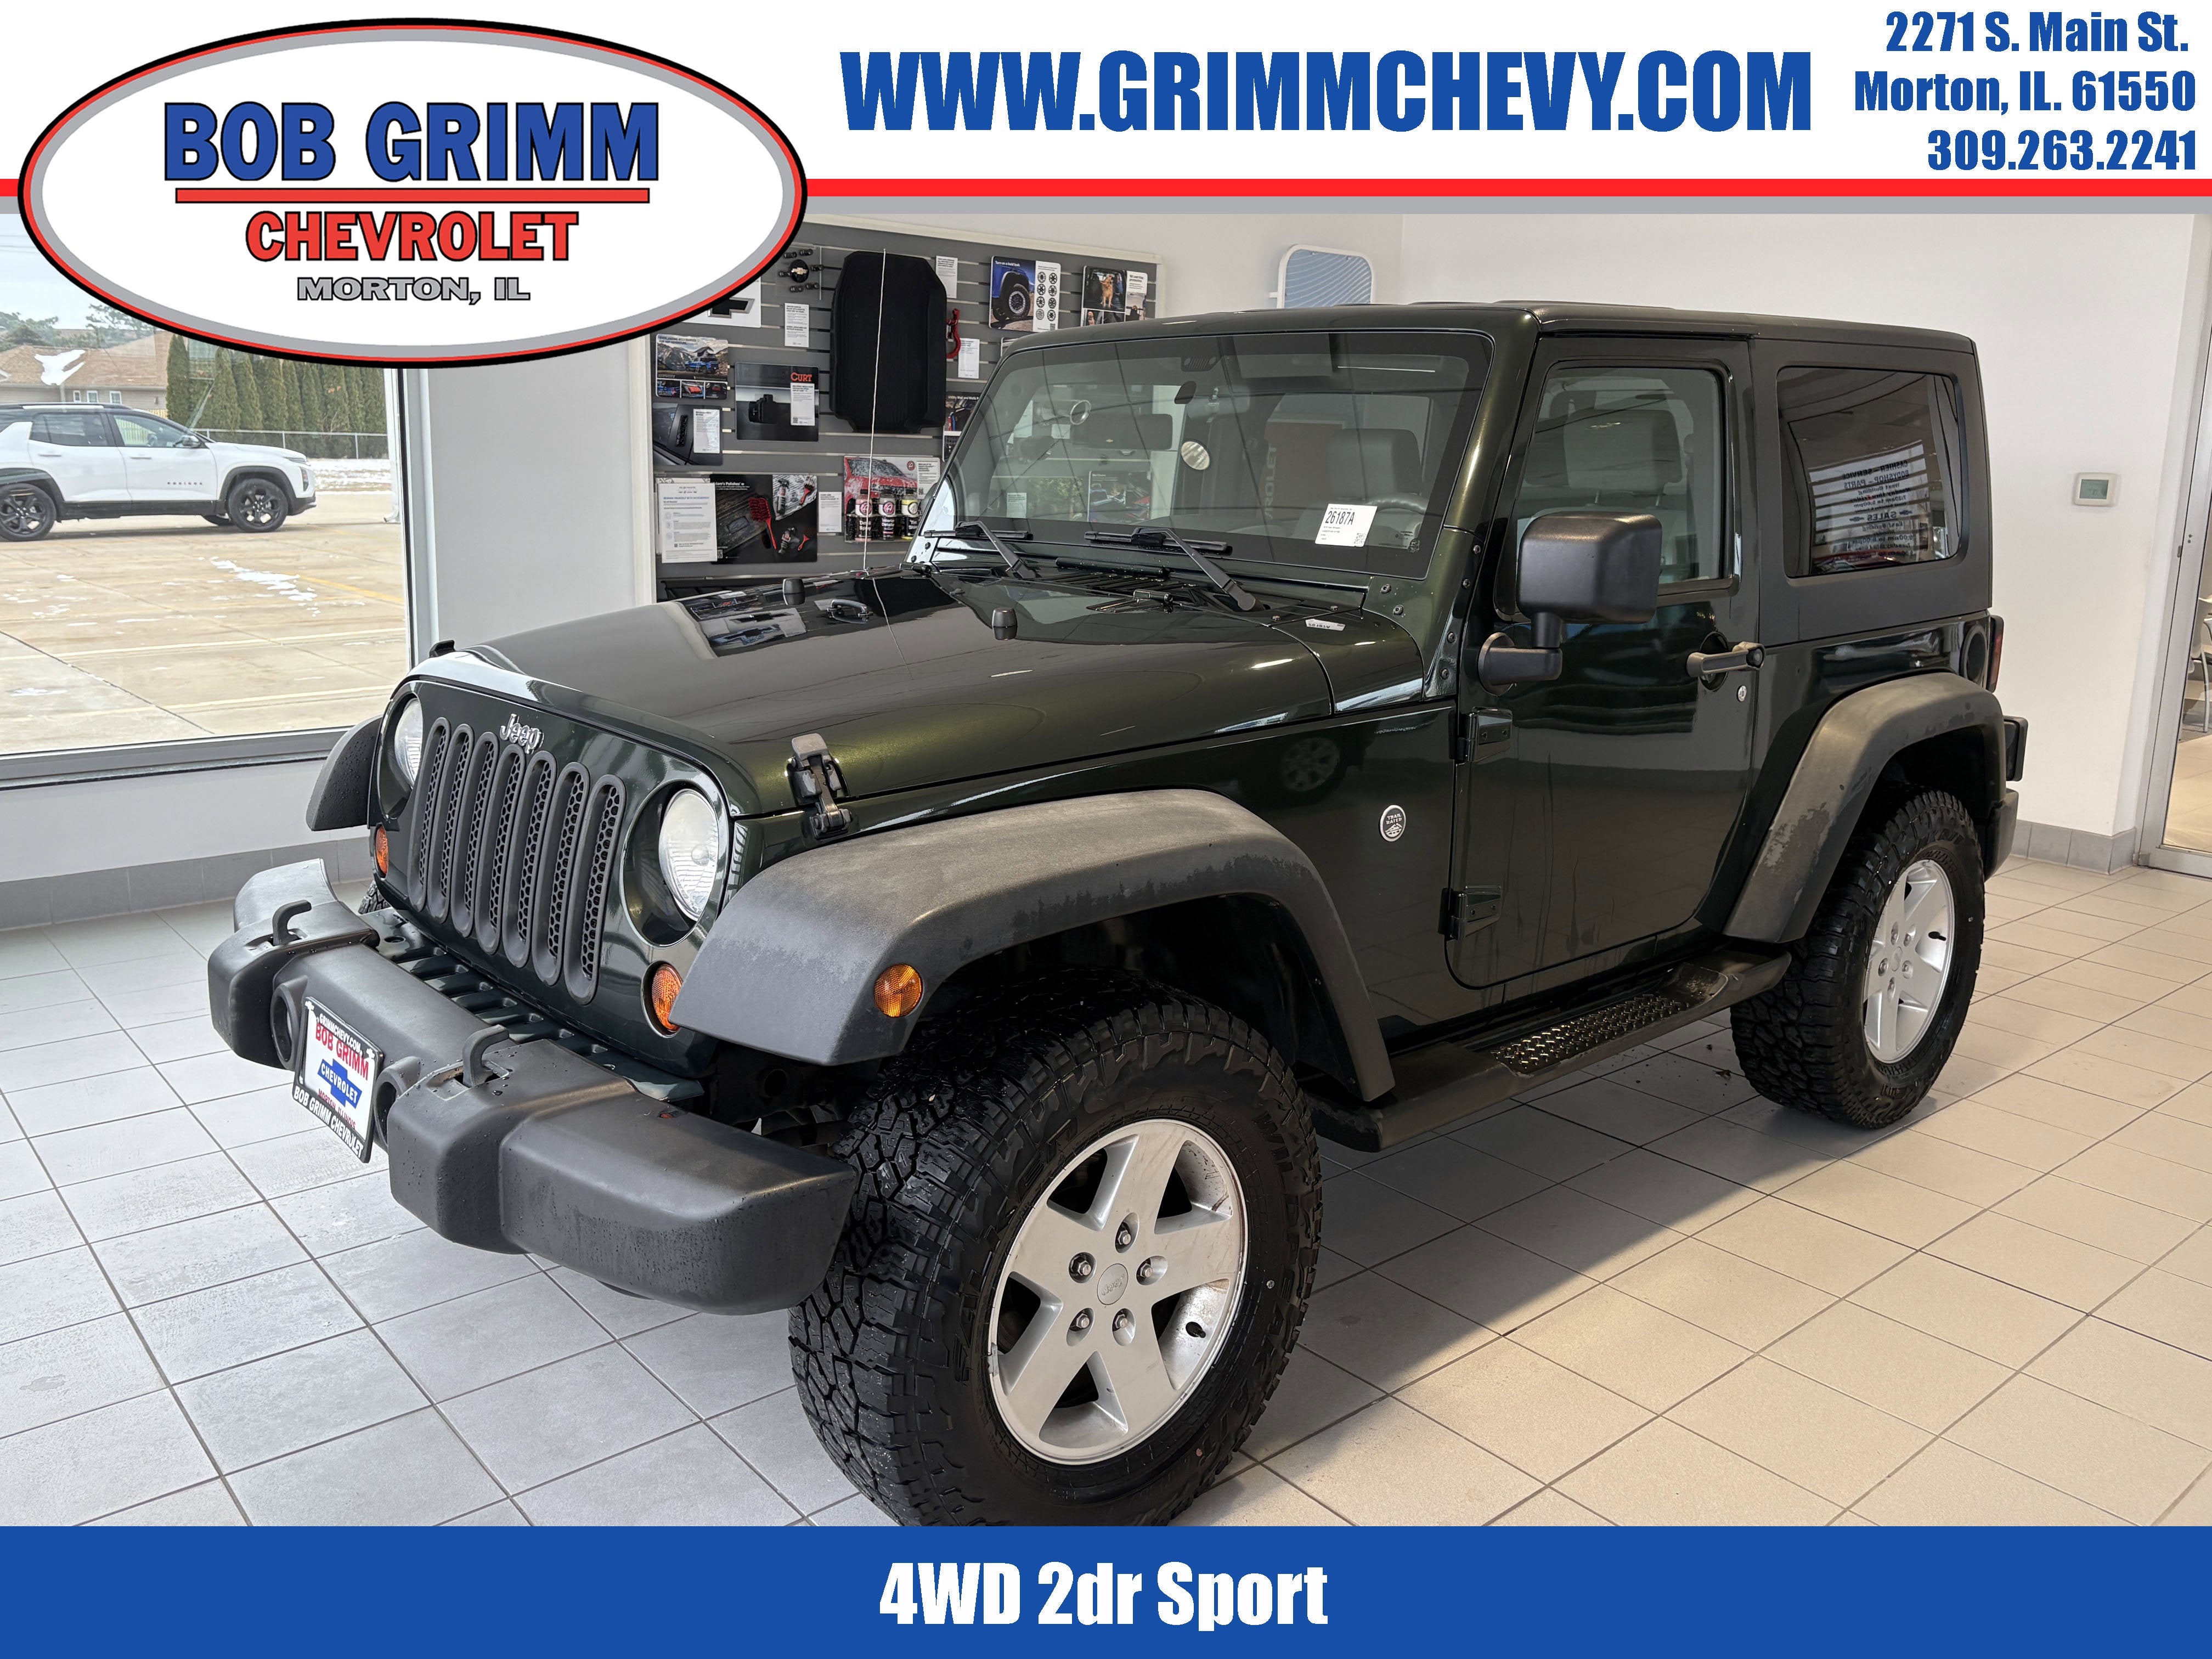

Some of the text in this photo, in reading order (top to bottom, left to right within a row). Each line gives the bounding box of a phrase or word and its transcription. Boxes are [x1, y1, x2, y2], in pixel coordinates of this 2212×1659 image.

[791, 372, 812, 382] CURT
[1325, 510, 1355, 525] 26187A
[500, 713, 544, 754] Jeep
[315, 1023, 369, 1081] BOB GRIMM
[319, 1013, 362, 1053] GRIMMCHEVY.COM
[320, 1063, 359, 1104] CHEVROLET
[294, 1085, 364, 1159] BOB GRIMM CHEVROLET
[318, 1088, 356, 1130] MORTON ILLINOIS
